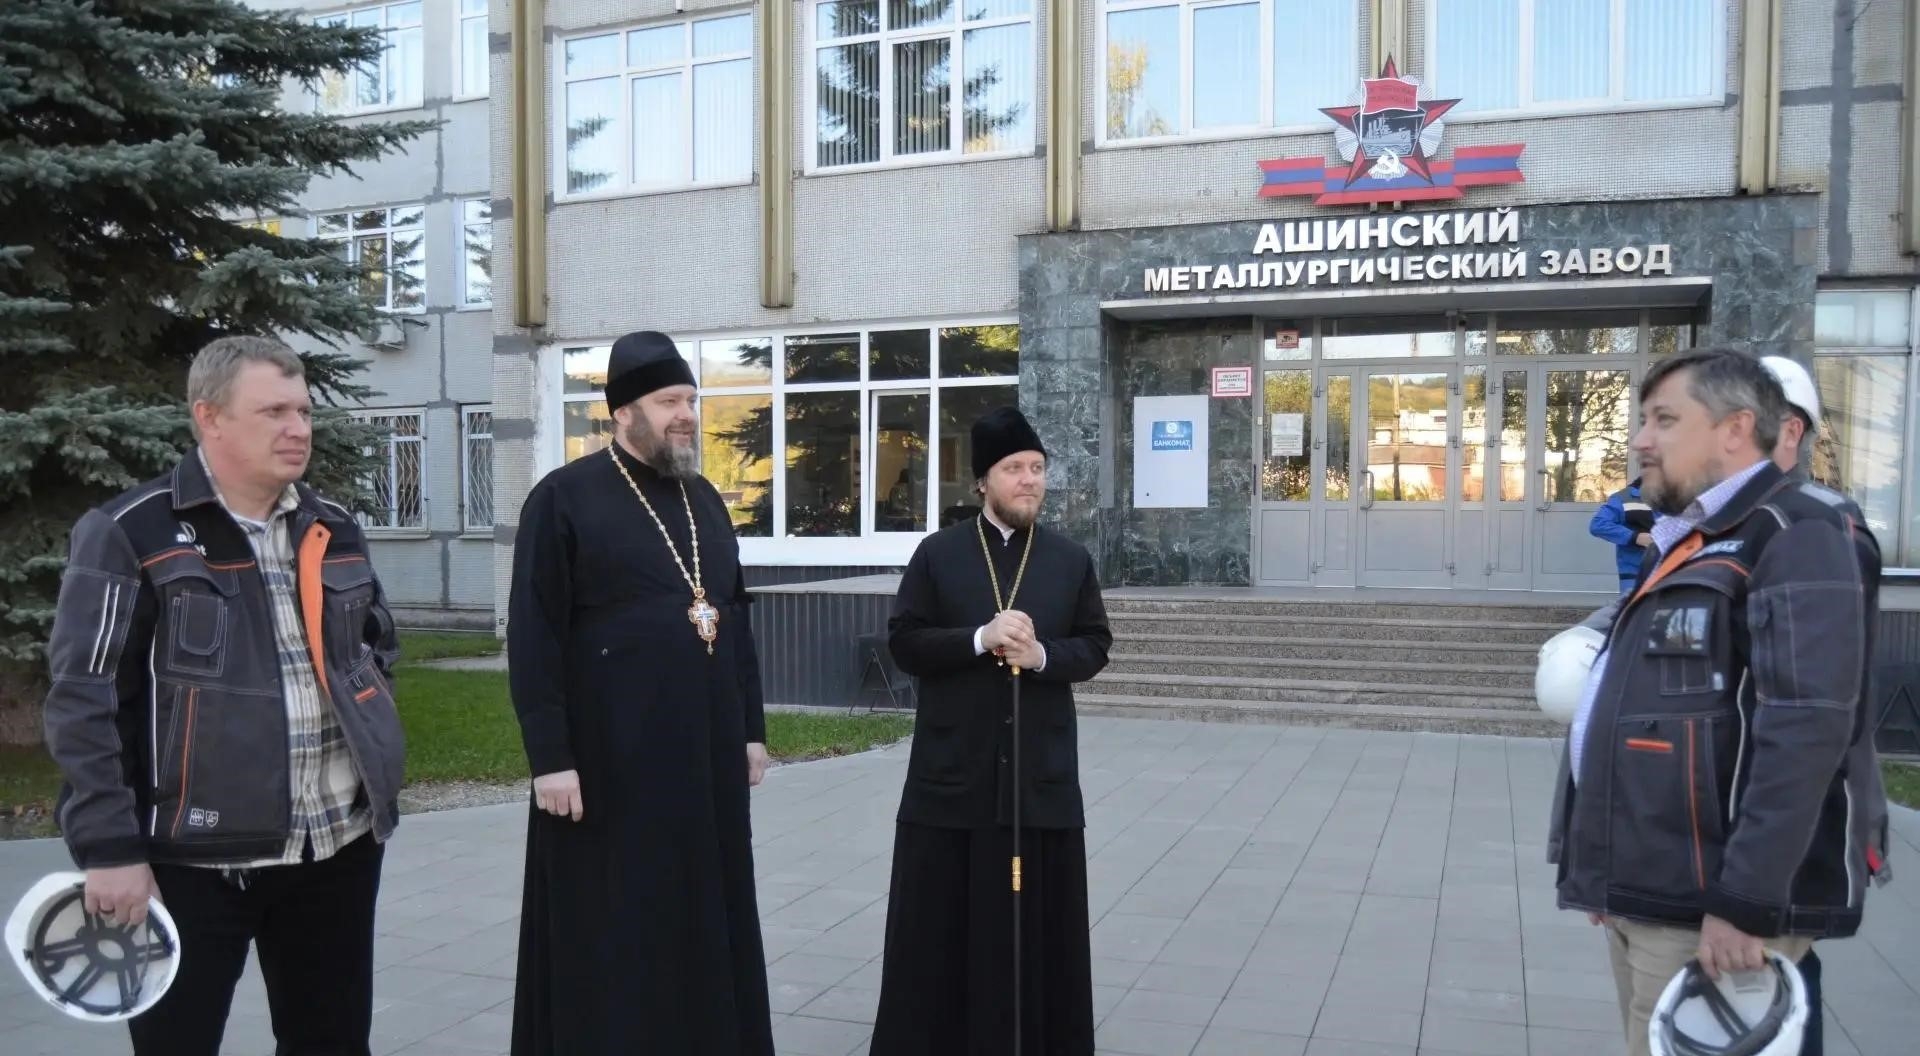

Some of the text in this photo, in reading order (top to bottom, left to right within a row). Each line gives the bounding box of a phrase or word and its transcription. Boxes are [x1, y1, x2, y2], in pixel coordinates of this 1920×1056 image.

[1253, 207, 1519, 254] АШИНСКИЙ
[1144, 244, 1672, 291] МЕТАЛЛУРГИЧЕСКИЙ ЗАВОД
